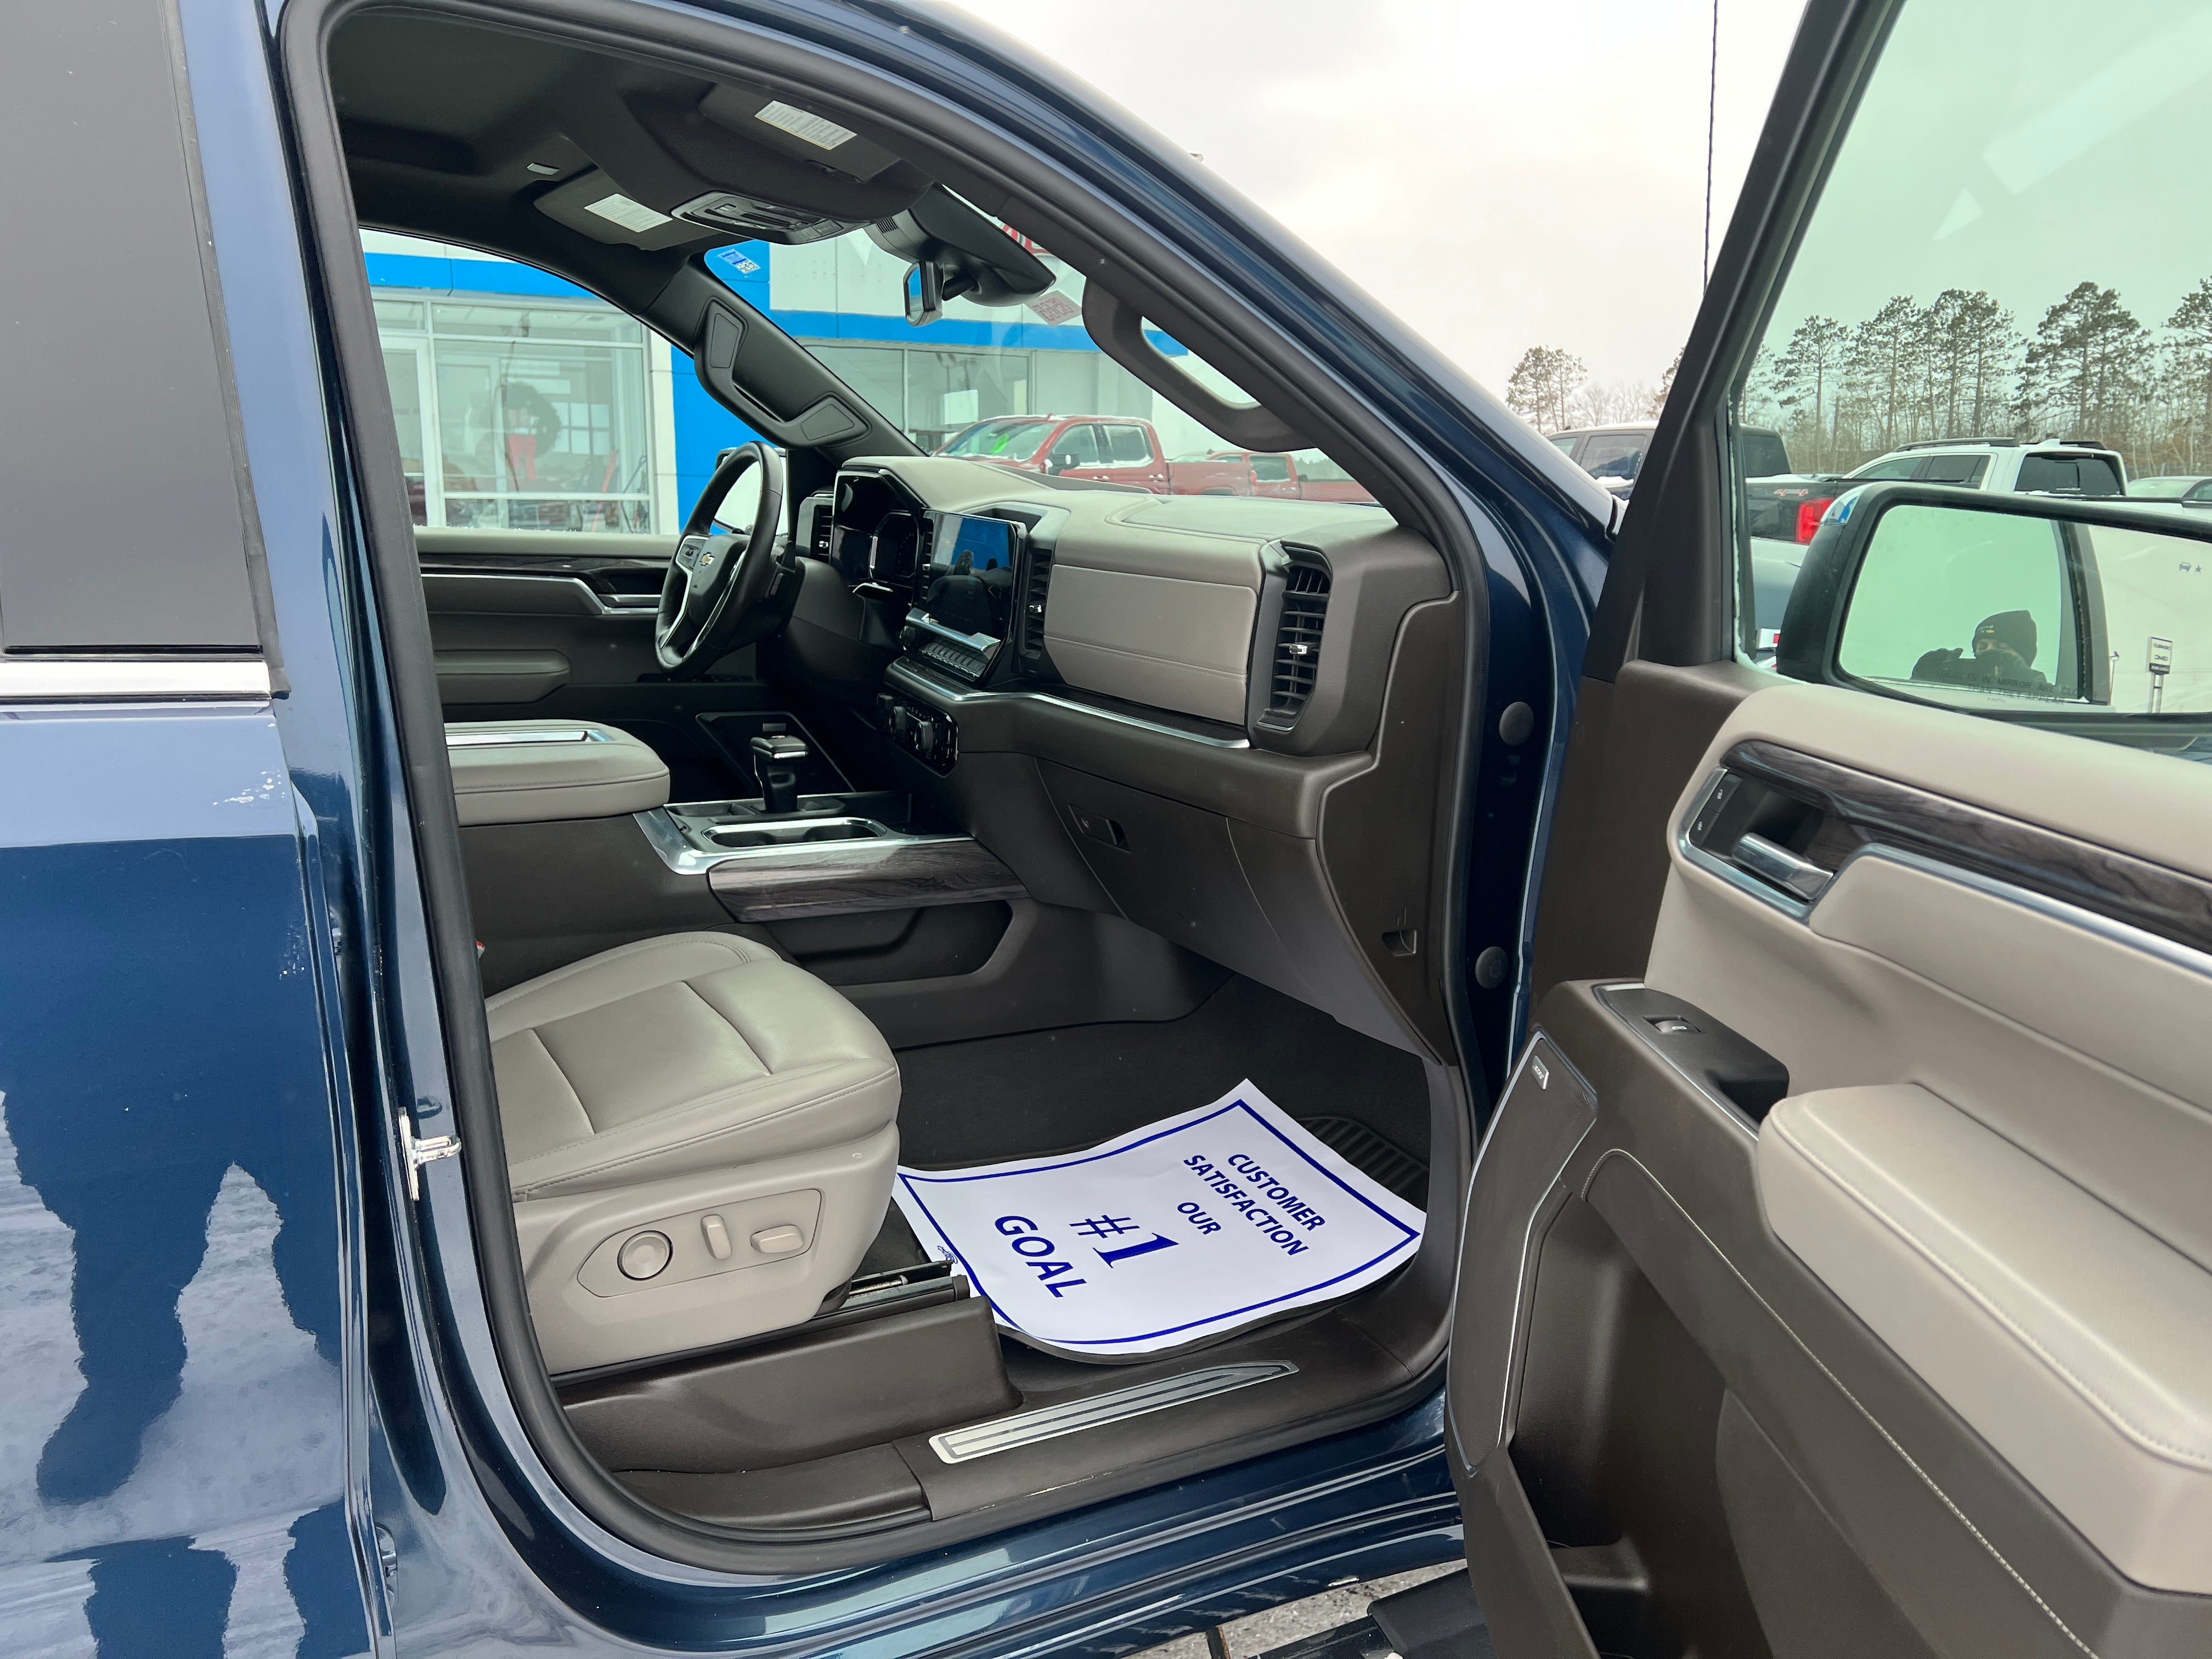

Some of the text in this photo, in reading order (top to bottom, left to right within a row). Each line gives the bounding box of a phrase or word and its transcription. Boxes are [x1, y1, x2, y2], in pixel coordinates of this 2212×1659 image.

[1937, 670, 1977, 681] OBJECTS
[1997, 678, 2032, 689] MIRROR
[2037, 684, 2055, 693] ARE
[2062, 686, 2097, 696] CLO
[1968, 684, 2064, 704] THAN THEY APPEAR
[1177, 1202, 1221, 1235] OUR
[1184, 1155, 1308, 1255] SATISFACTION
[1228, 1154, 1325, 1230] CUSTOMER
[995, 1216, 1086, 1298] GOAL
[1070, 1215, 1178, 1268] #1
